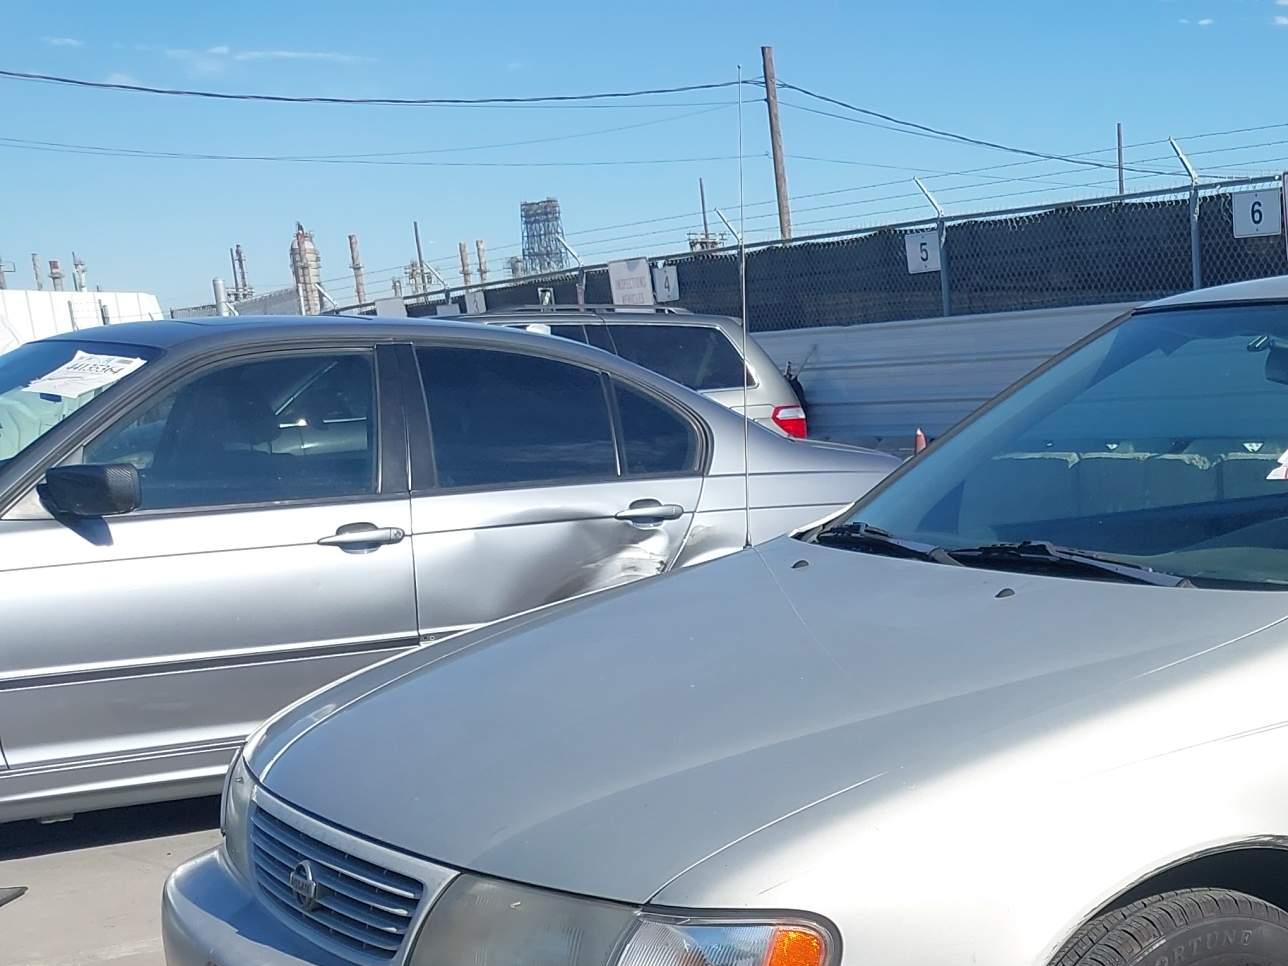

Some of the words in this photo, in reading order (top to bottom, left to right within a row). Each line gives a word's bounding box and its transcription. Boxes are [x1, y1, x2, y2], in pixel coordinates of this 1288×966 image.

[1251, 202, 1263, 225] 6
[920, 242, 929, 262] 5
[664, 276, 671, 292] 4
